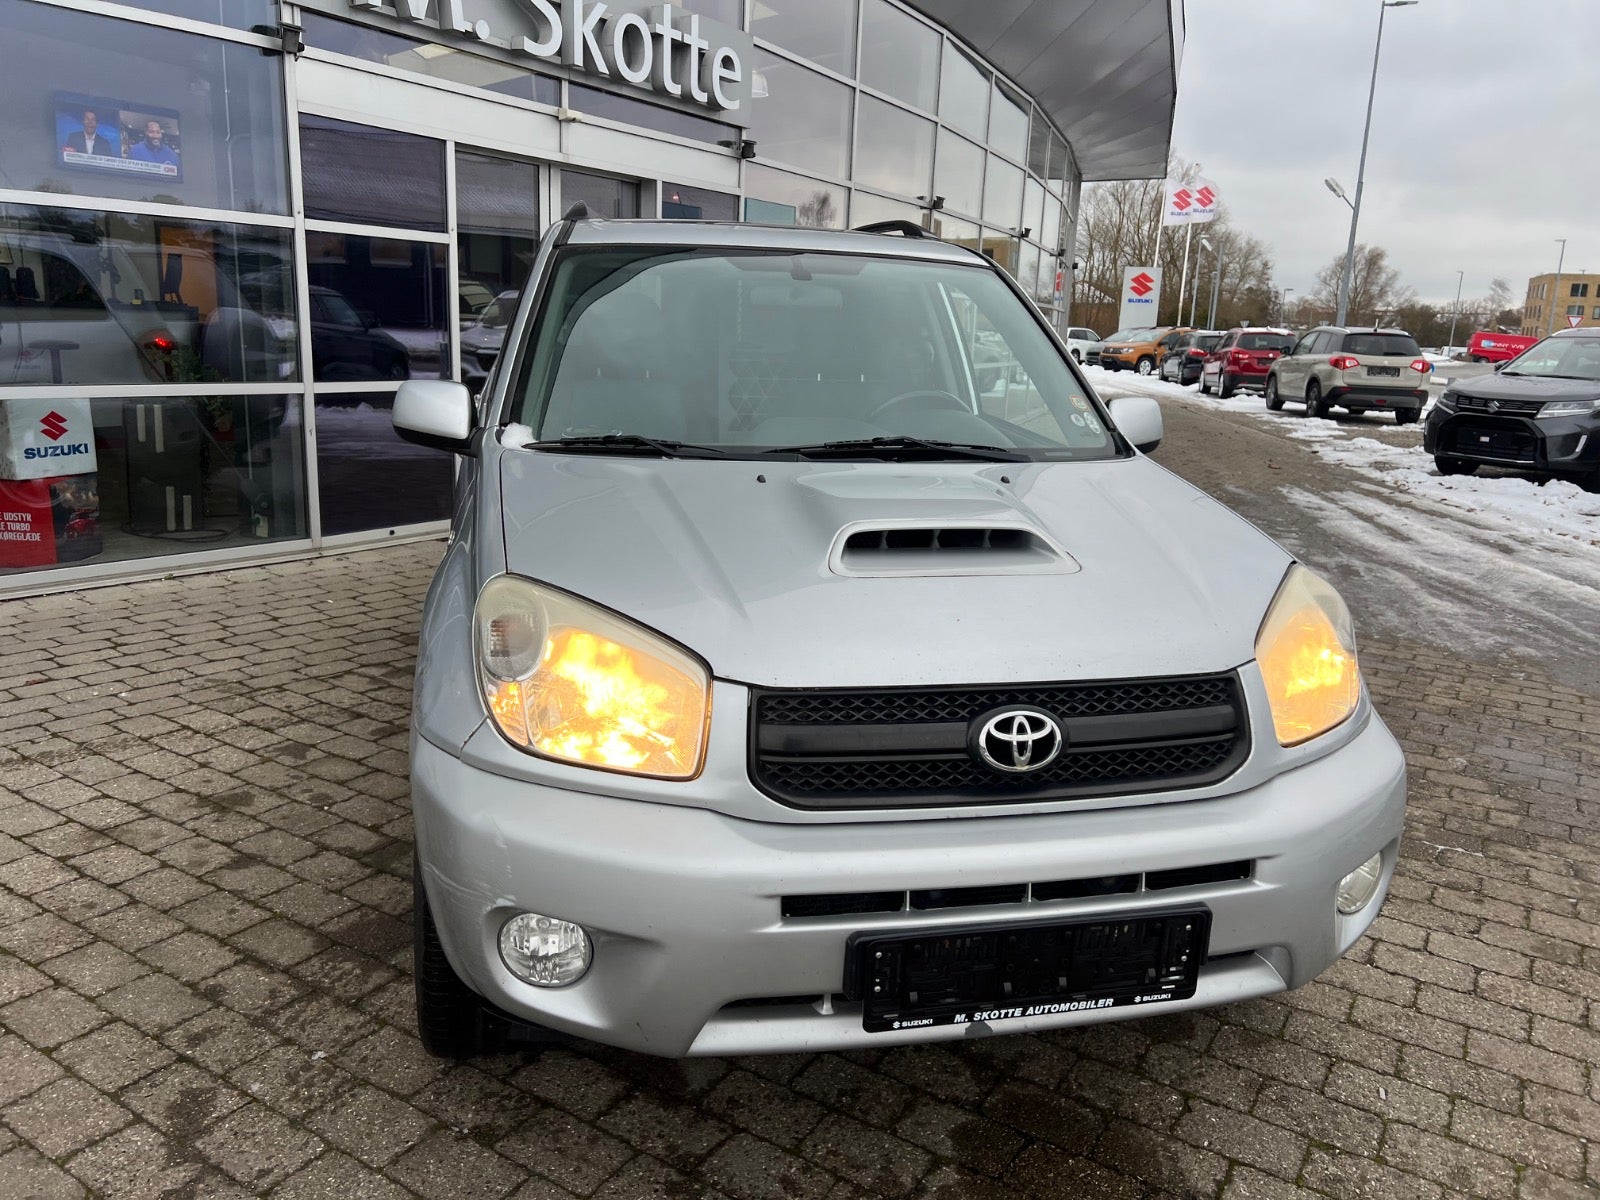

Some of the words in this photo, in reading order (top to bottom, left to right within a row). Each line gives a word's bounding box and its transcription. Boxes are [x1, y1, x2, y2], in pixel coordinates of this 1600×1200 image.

[511, 0, 742, 110] Skotte
[24, 443, 89, 460] SUZUKI
[3, 512, 32, 522] UDSTYR
[6, 522, 31, 531] TURBO
[901, 1018, 933, 1028] SUZUKI
[953, 1013, 969, 1024] M.
[973, 1007, 1023, 1022] SKOTTE
[1025, 998, 1114, 1016] AUTOMOBILER
[1142, 993, 1171, 1002] SUZUKI
